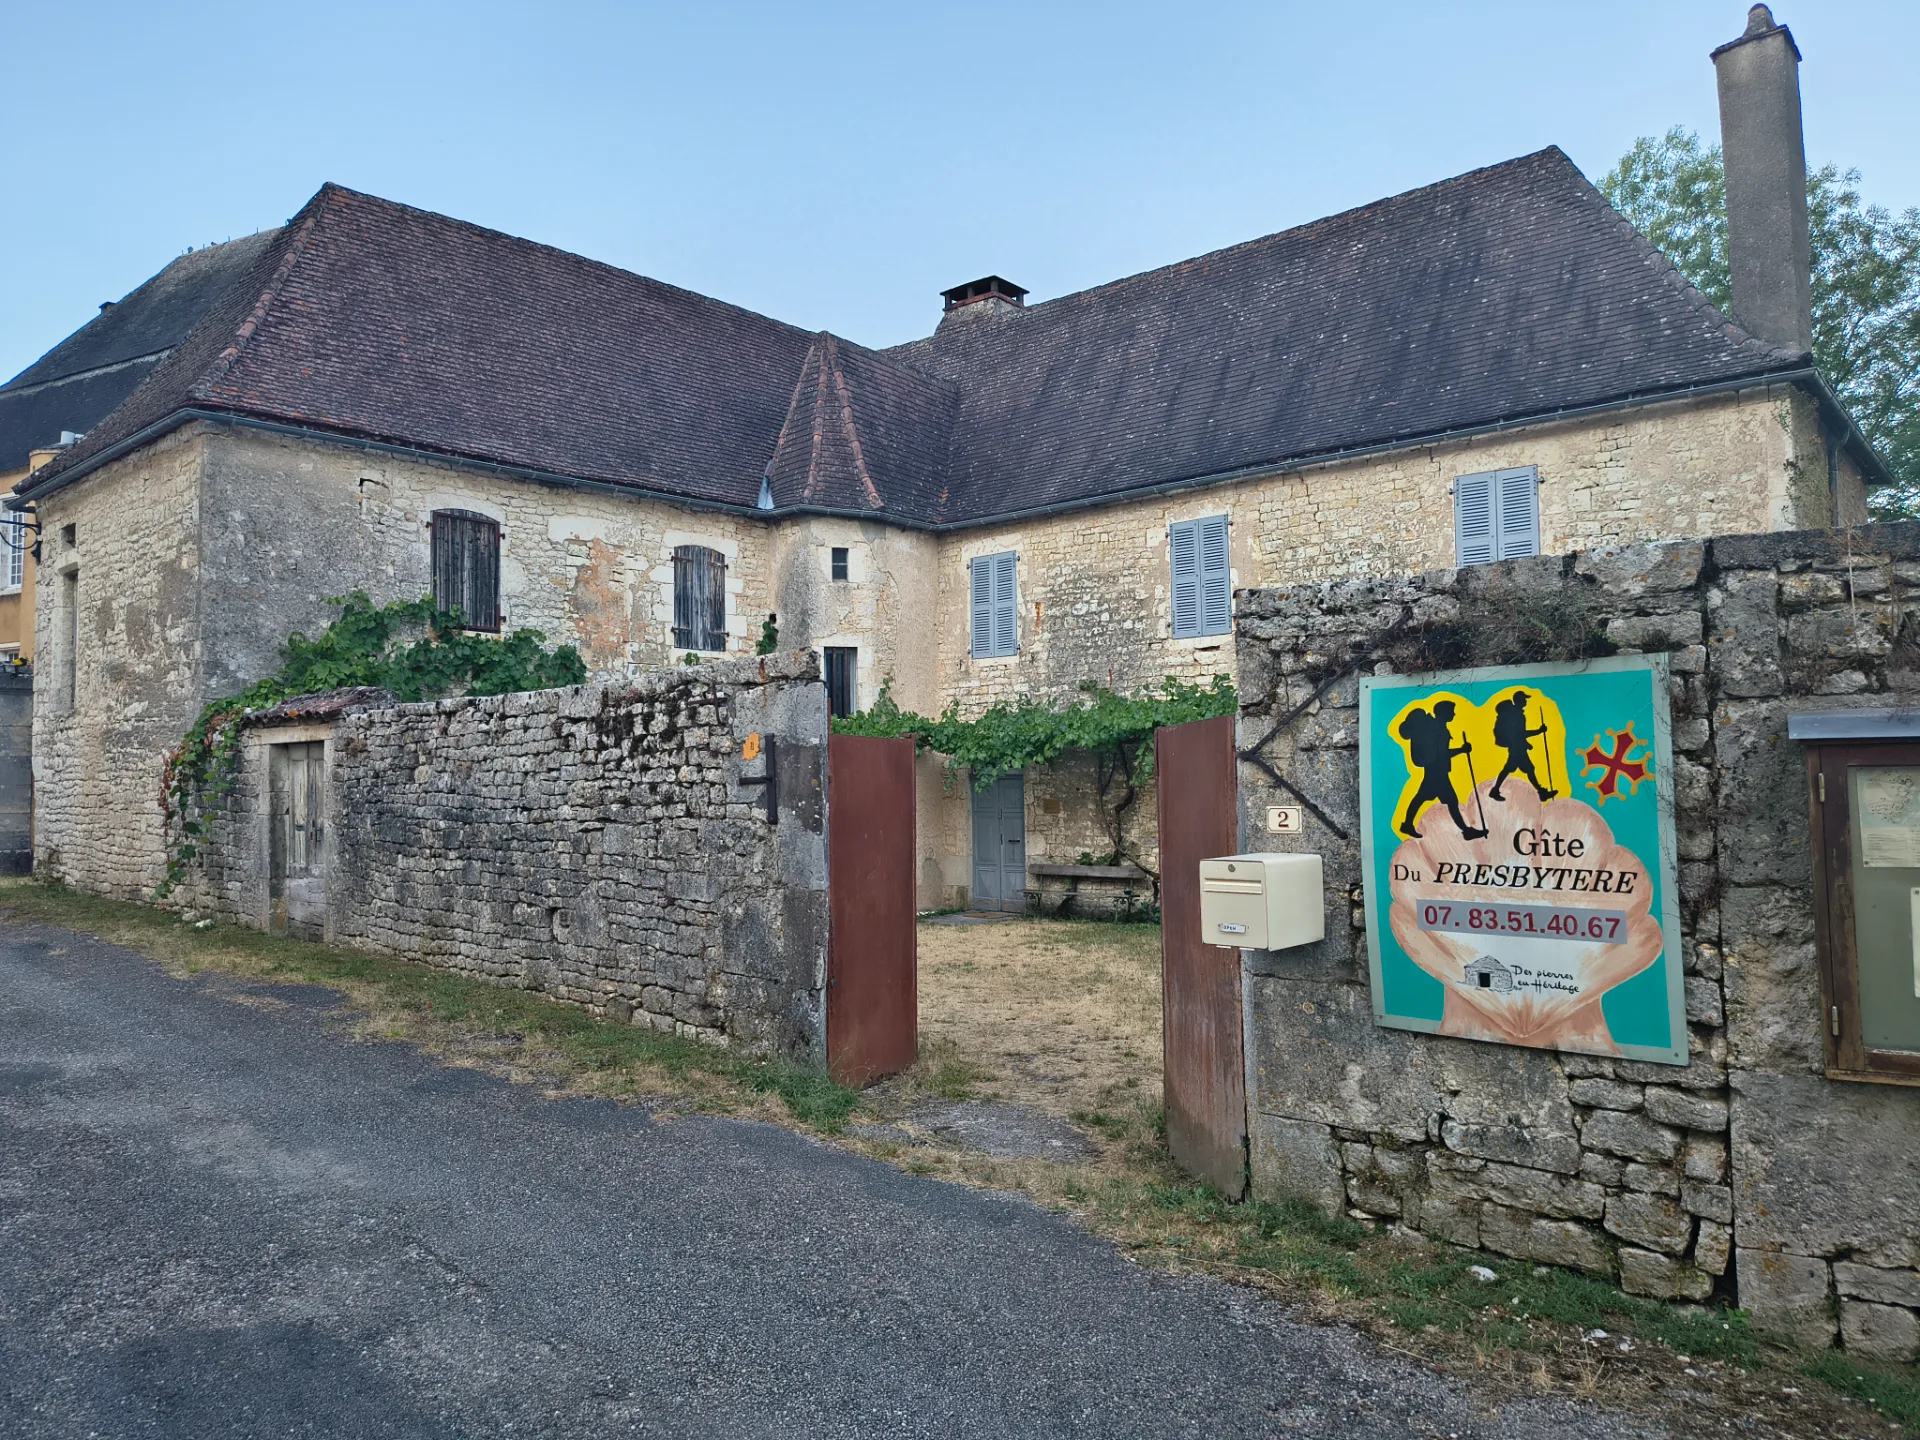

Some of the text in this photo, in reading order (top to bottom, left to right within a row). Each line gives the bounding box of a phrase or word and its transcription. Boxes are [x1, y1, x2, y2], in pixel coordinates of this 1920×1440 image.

[1277, 811, 1289, 828] 2
[1513, 828, 1585, 858] Gîte
[1394, 862, 1638, 894] Du PRESBYTERE
[1510, 964, 1573, 980] Des pierres
